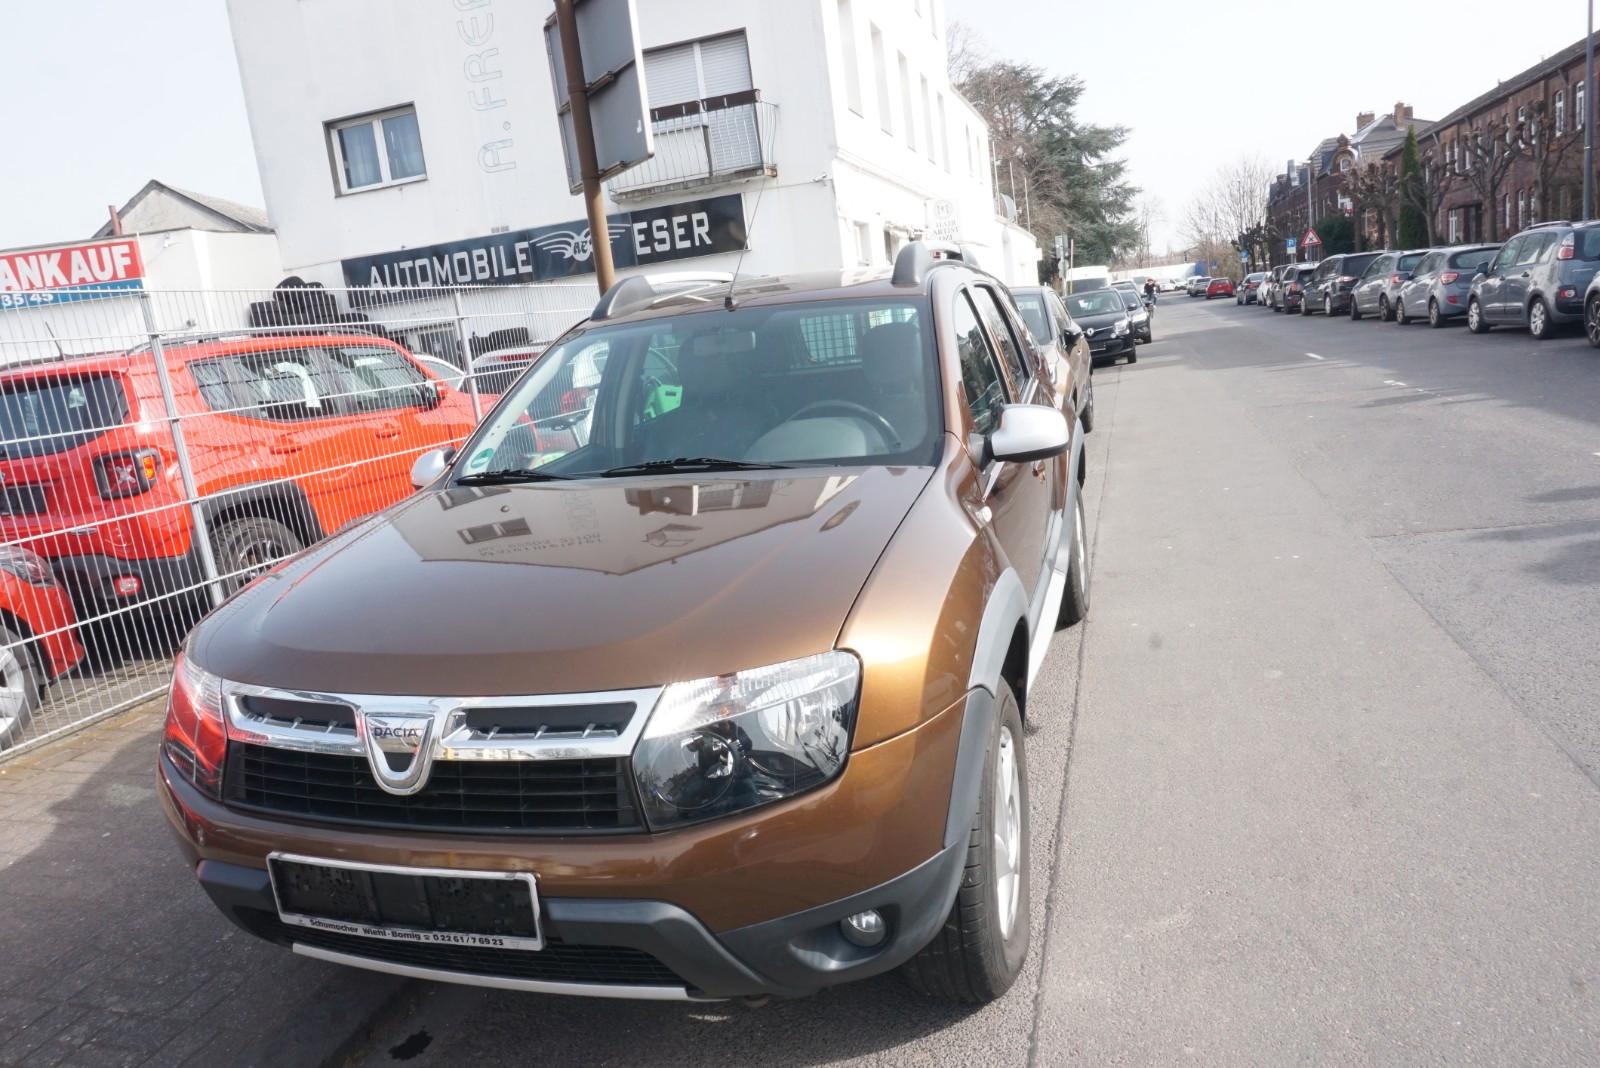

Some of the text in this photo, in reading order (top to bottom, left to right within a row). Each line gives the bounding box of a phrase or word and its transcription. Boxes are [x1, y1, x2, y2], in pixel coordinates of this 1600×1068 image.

[0, 244, 131, 291] ANKAUF
[369, 211, 713, 296] AUTOMOBILE ESER
[373, 727, 418, 738] DACIA
[309, 918, 359, 934] Schumacher
